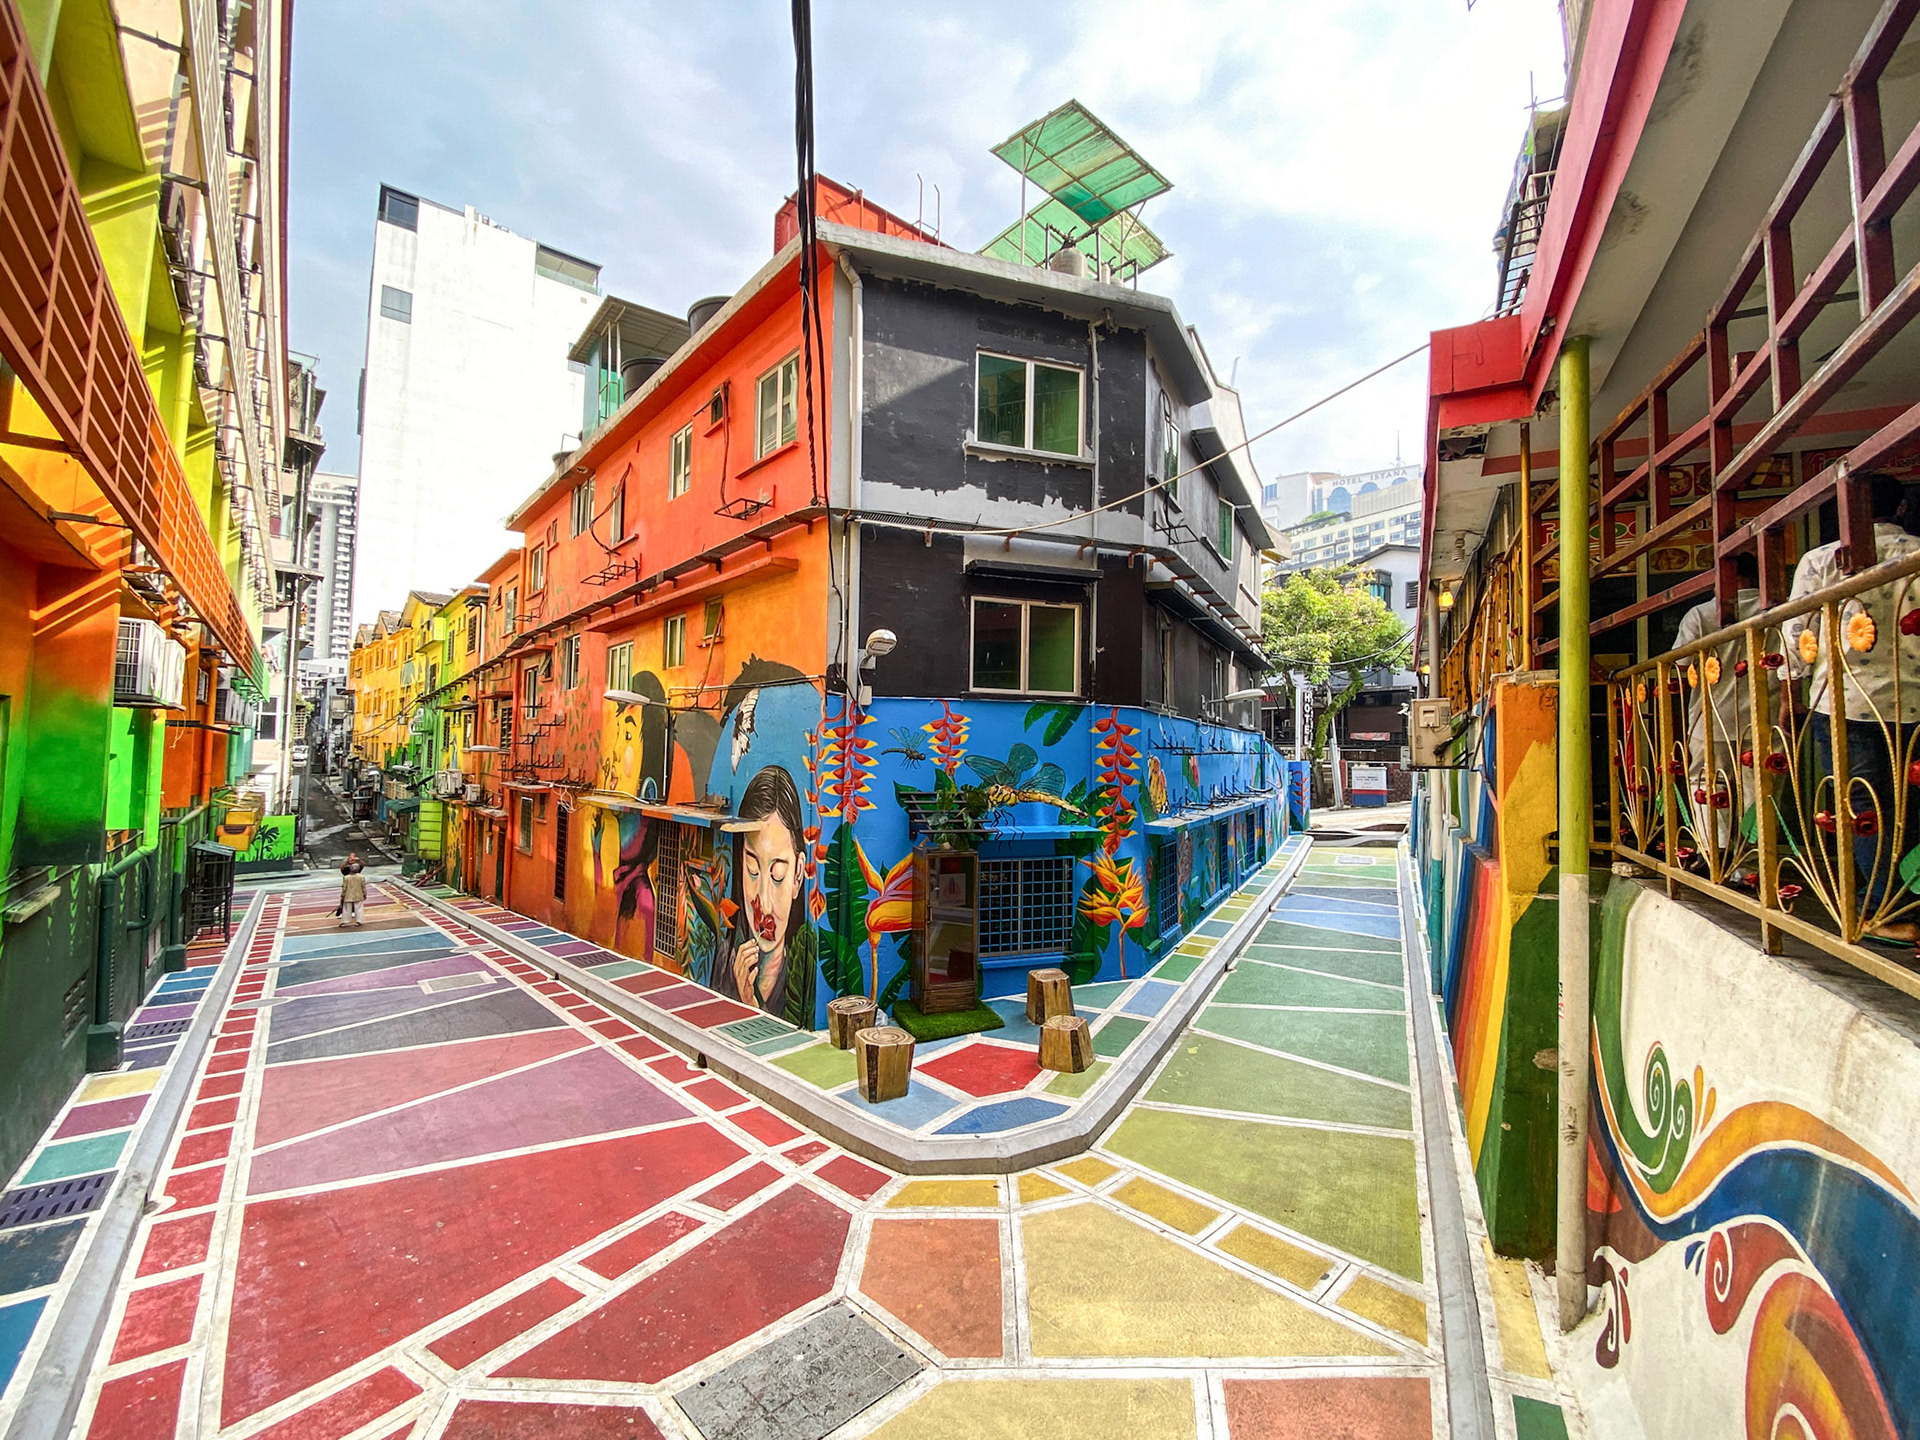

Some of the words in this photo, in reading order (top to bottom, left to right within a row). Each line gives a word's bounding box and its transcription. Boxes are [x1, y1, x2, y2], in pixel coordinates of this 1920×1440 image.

[1332, 477, 1363, 487] HOTEL
[1370, 469, 1408, 480] ISTANA
[1303, 691, 1311, 745] HOTEL
